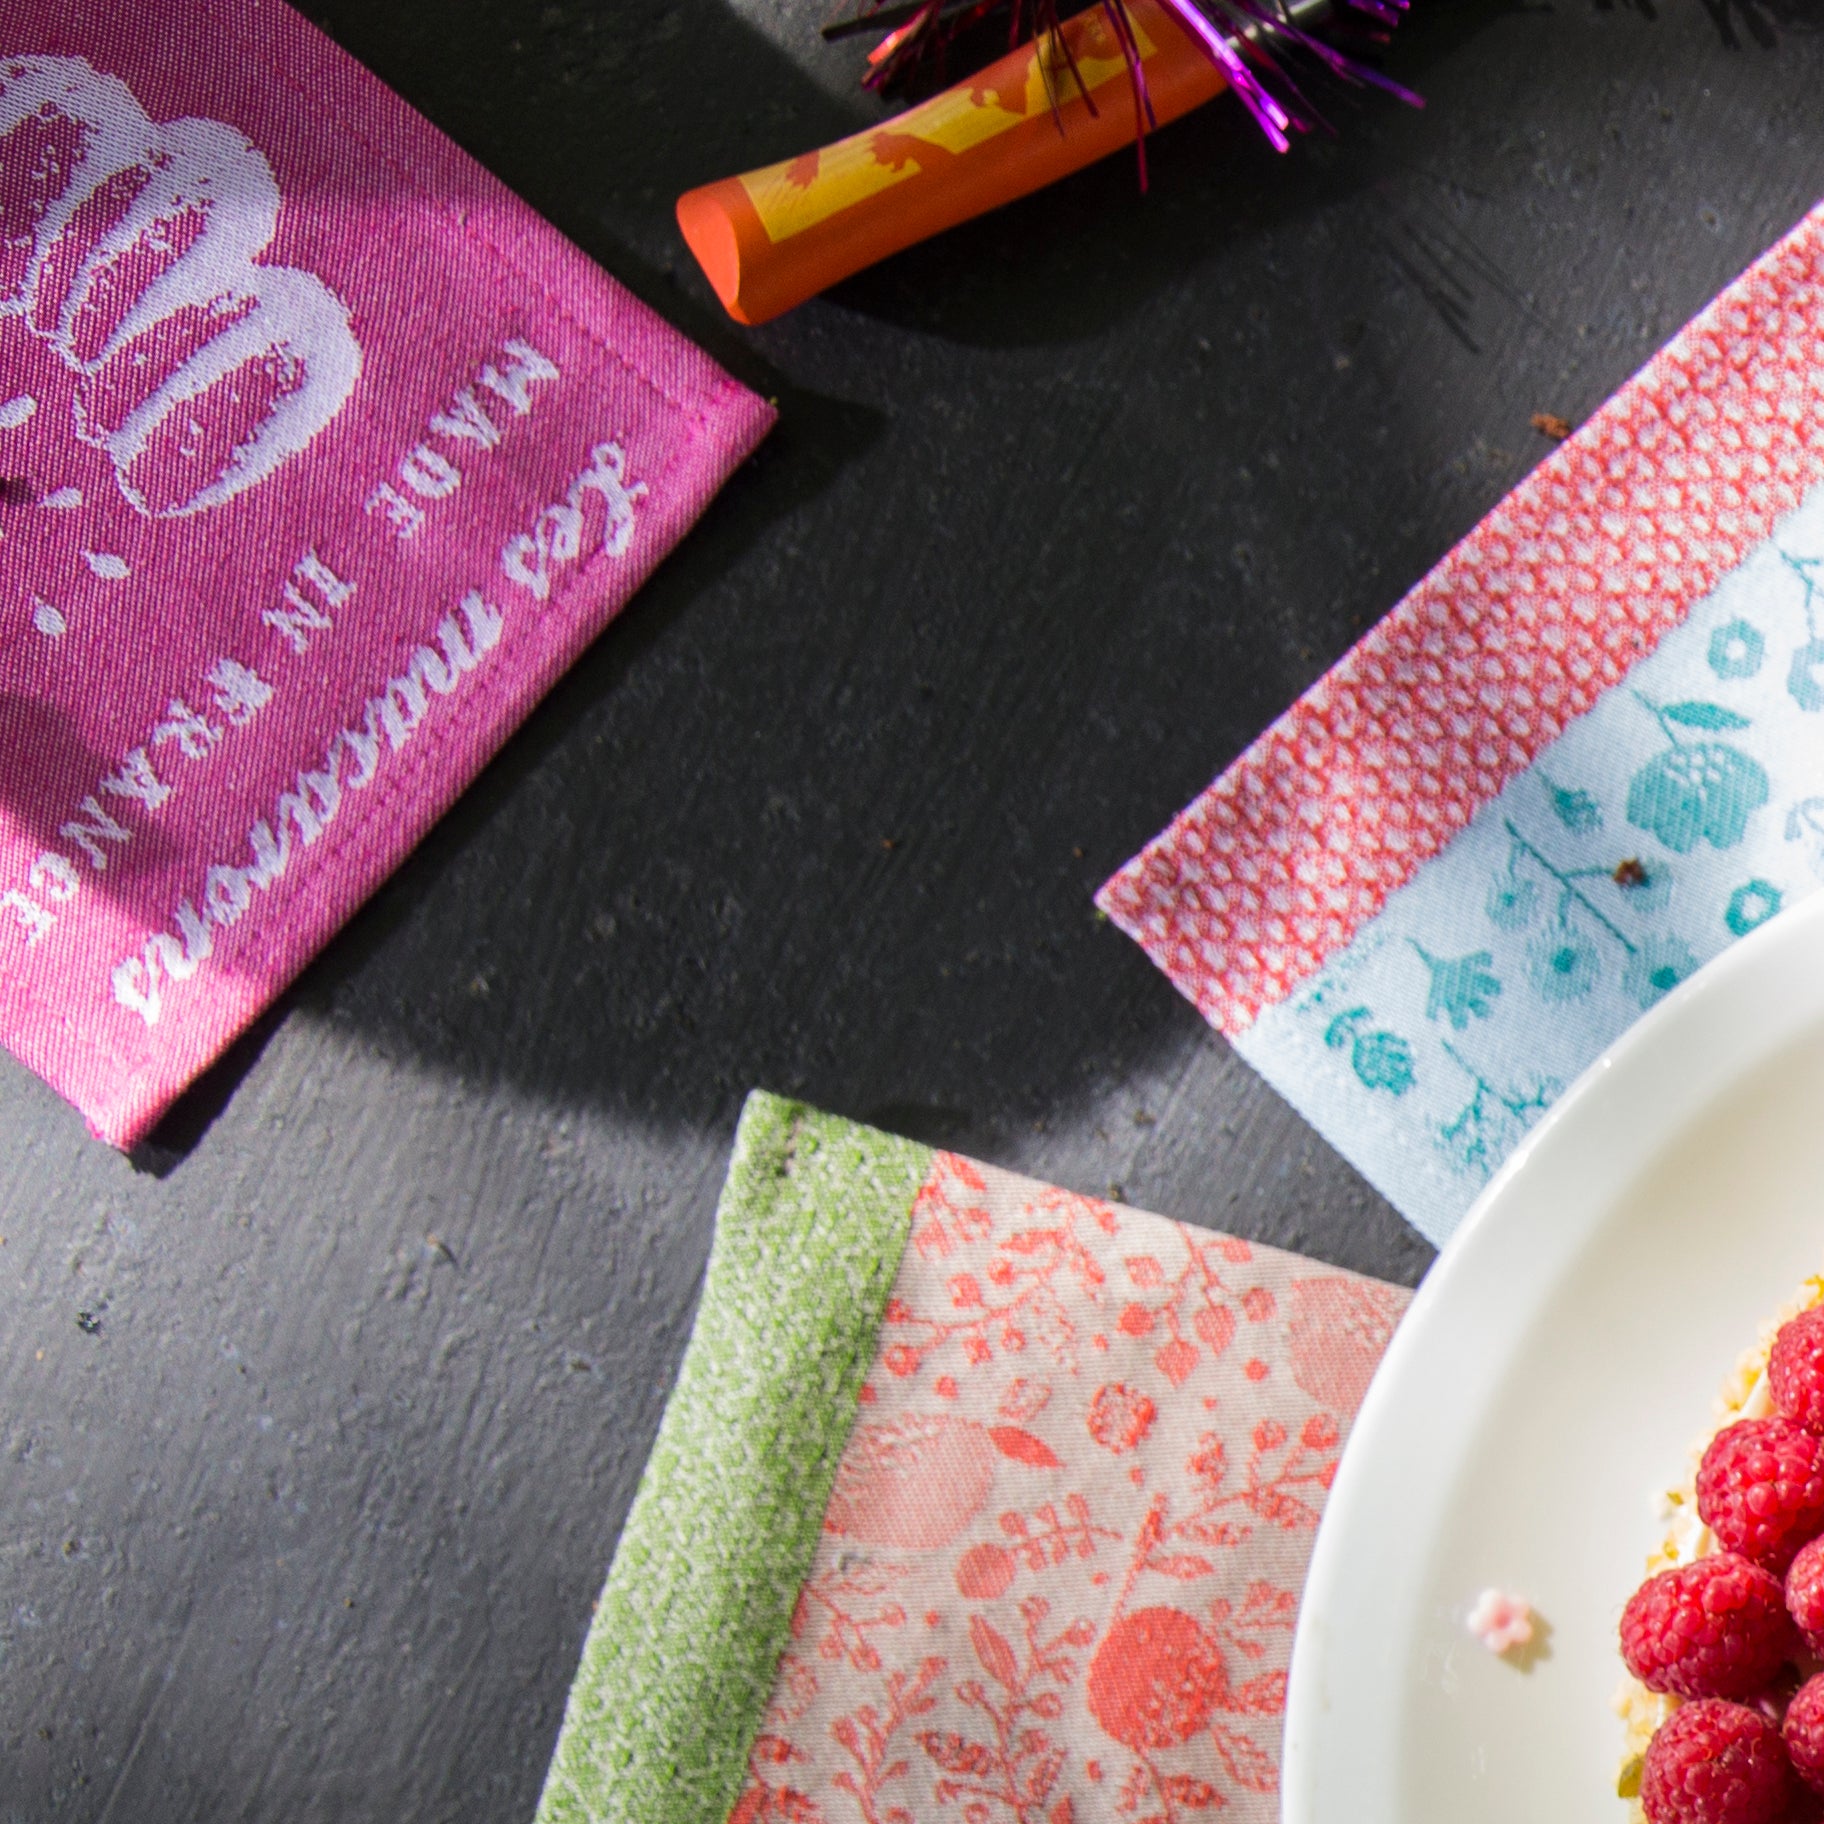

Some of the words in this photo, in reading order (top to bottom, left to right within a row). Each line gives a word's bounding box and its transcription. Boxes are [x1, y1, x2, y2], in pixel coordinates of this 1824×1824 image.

[363, 337, 561, 540] MADE
[500, 440, 650, 601] Les
[261, 548, 357, 656] IN
[1, 657, 274, 947] FRANCE
[111, 589, 504, 1028] macarons
